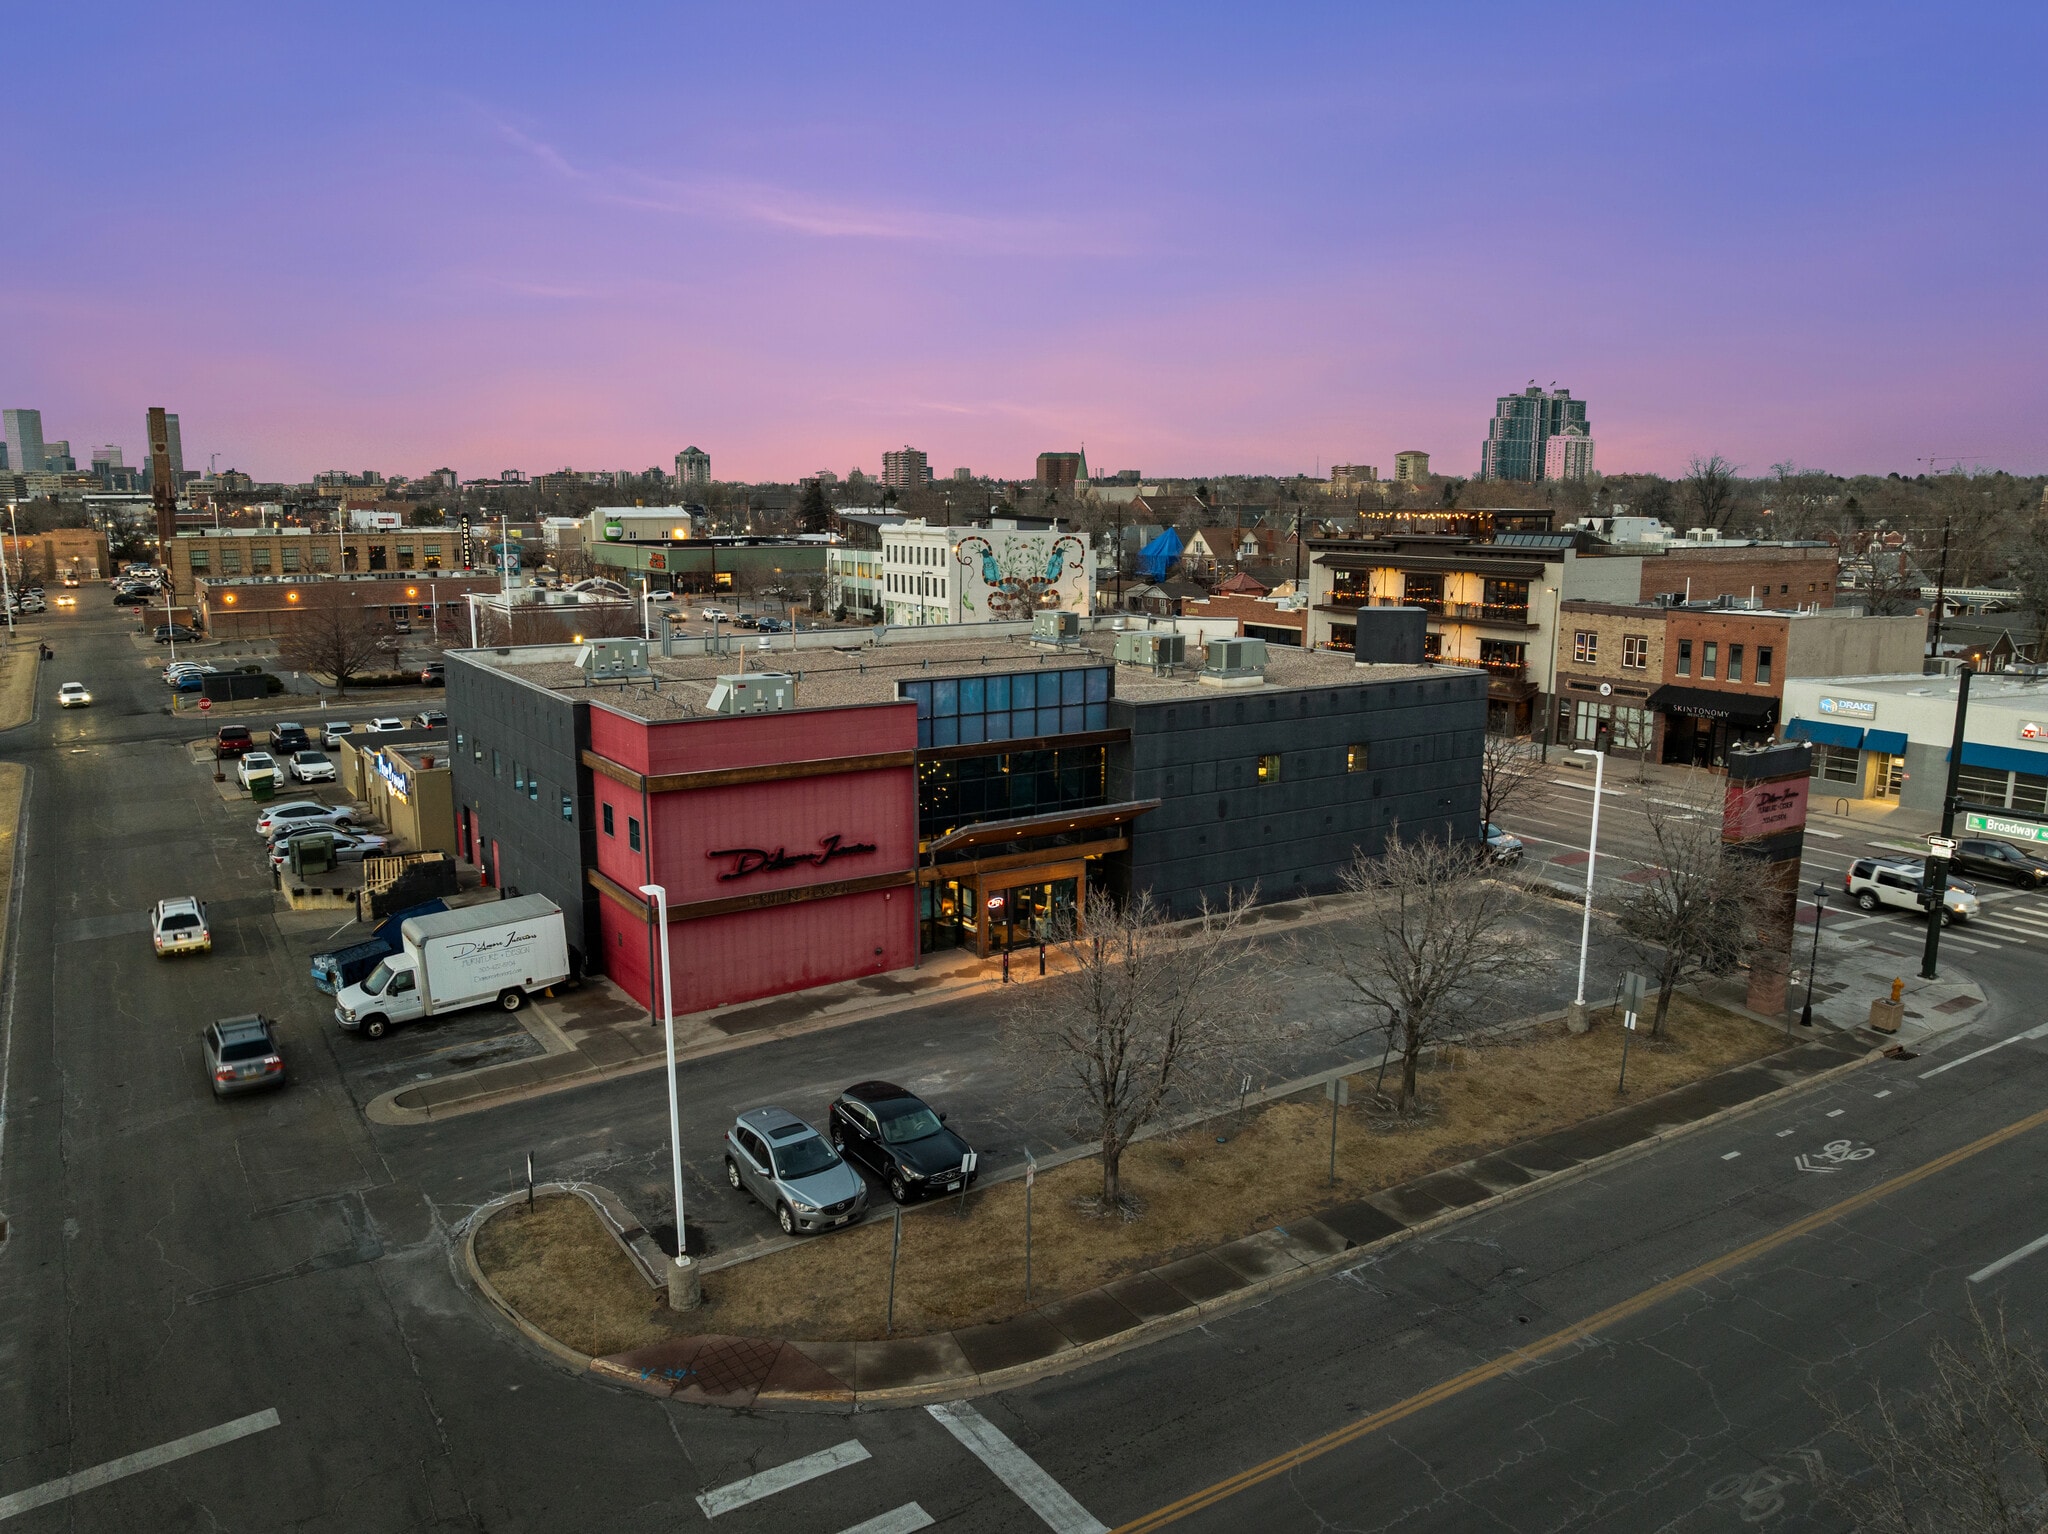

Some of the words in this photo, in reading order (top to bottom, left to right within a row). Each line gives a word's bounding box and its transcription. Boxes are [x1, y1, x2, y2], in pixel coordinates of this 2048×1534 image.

[1673, 704, 1730, 718] SKINTONOMY
[1839, 700, 1873, 712] DRAKE
[1986, 818, 2038, 840] Broadway
